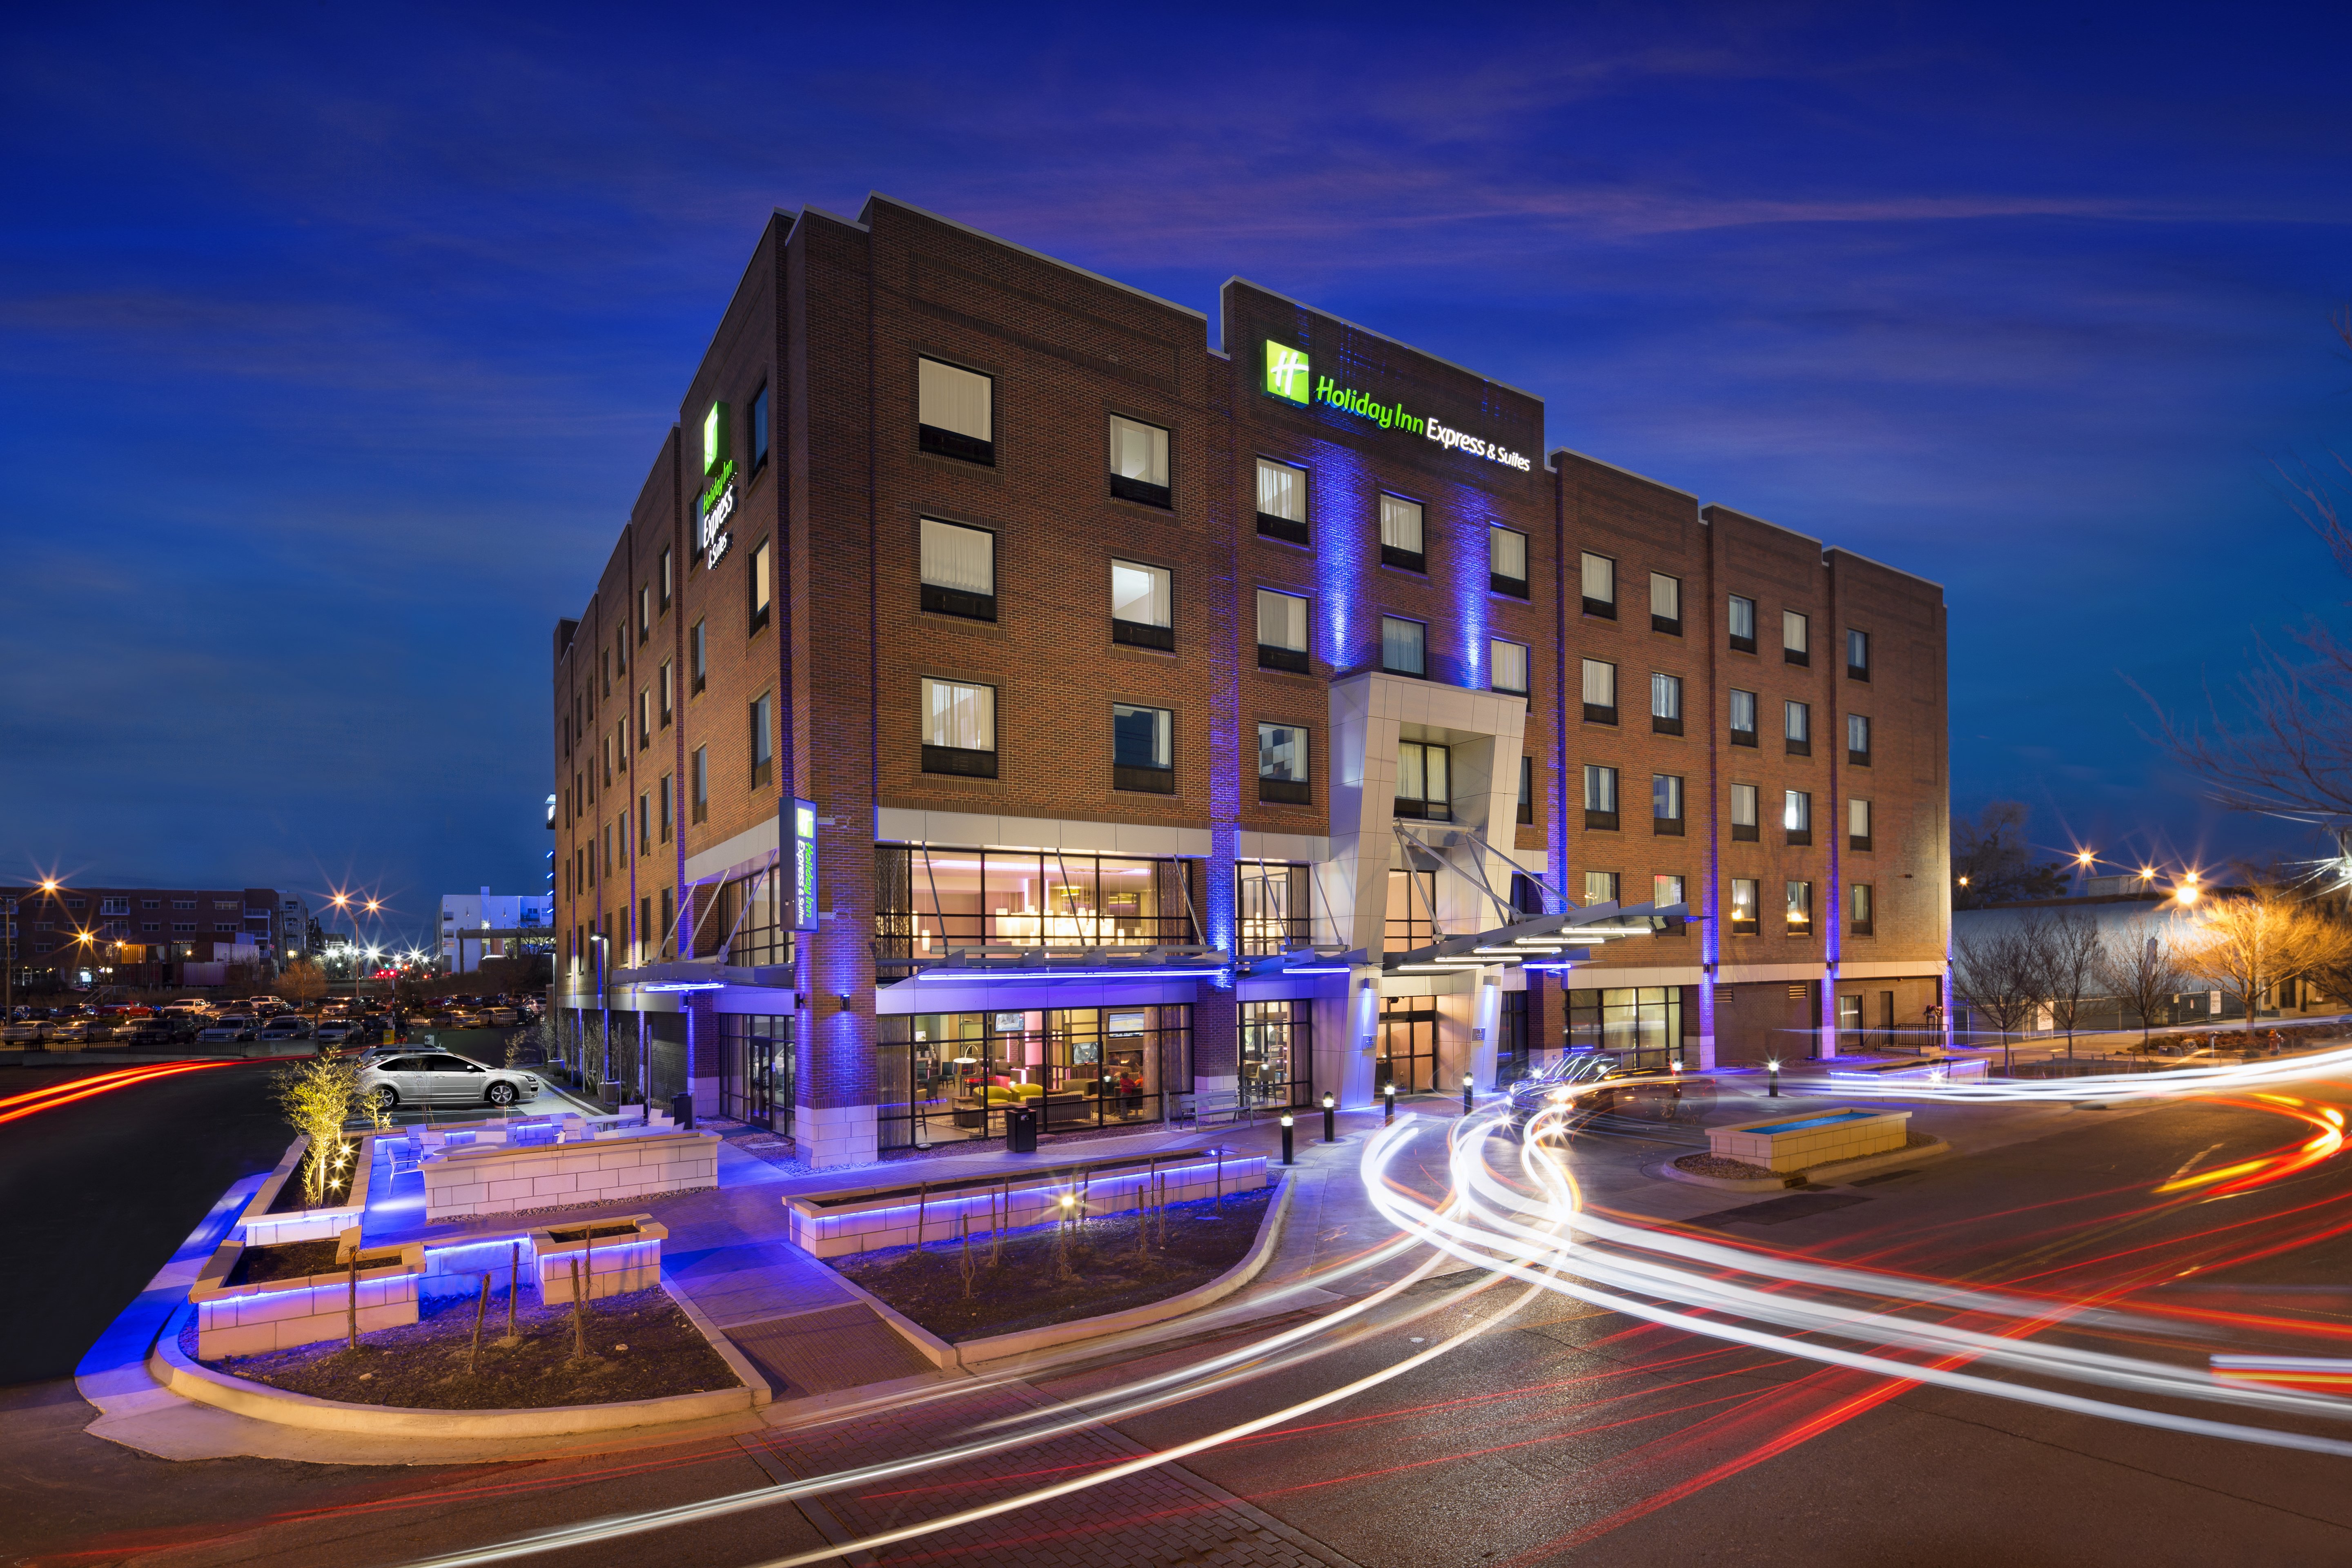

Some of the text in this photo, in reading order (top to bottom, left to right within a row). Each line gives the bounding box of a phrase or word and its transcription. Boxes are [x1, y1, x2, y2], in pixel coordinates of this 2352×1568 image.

[1316, 376, 1530, 471] Holiday Inn Express & Suites
[703, 460, 732, 516] Holiday Inn
[703, 485, 733, 548] Express
[708, 532, 727, 570] & Suites
[796, 839, 806, 887] Express
[803, 842, 813, 895] Holiday
